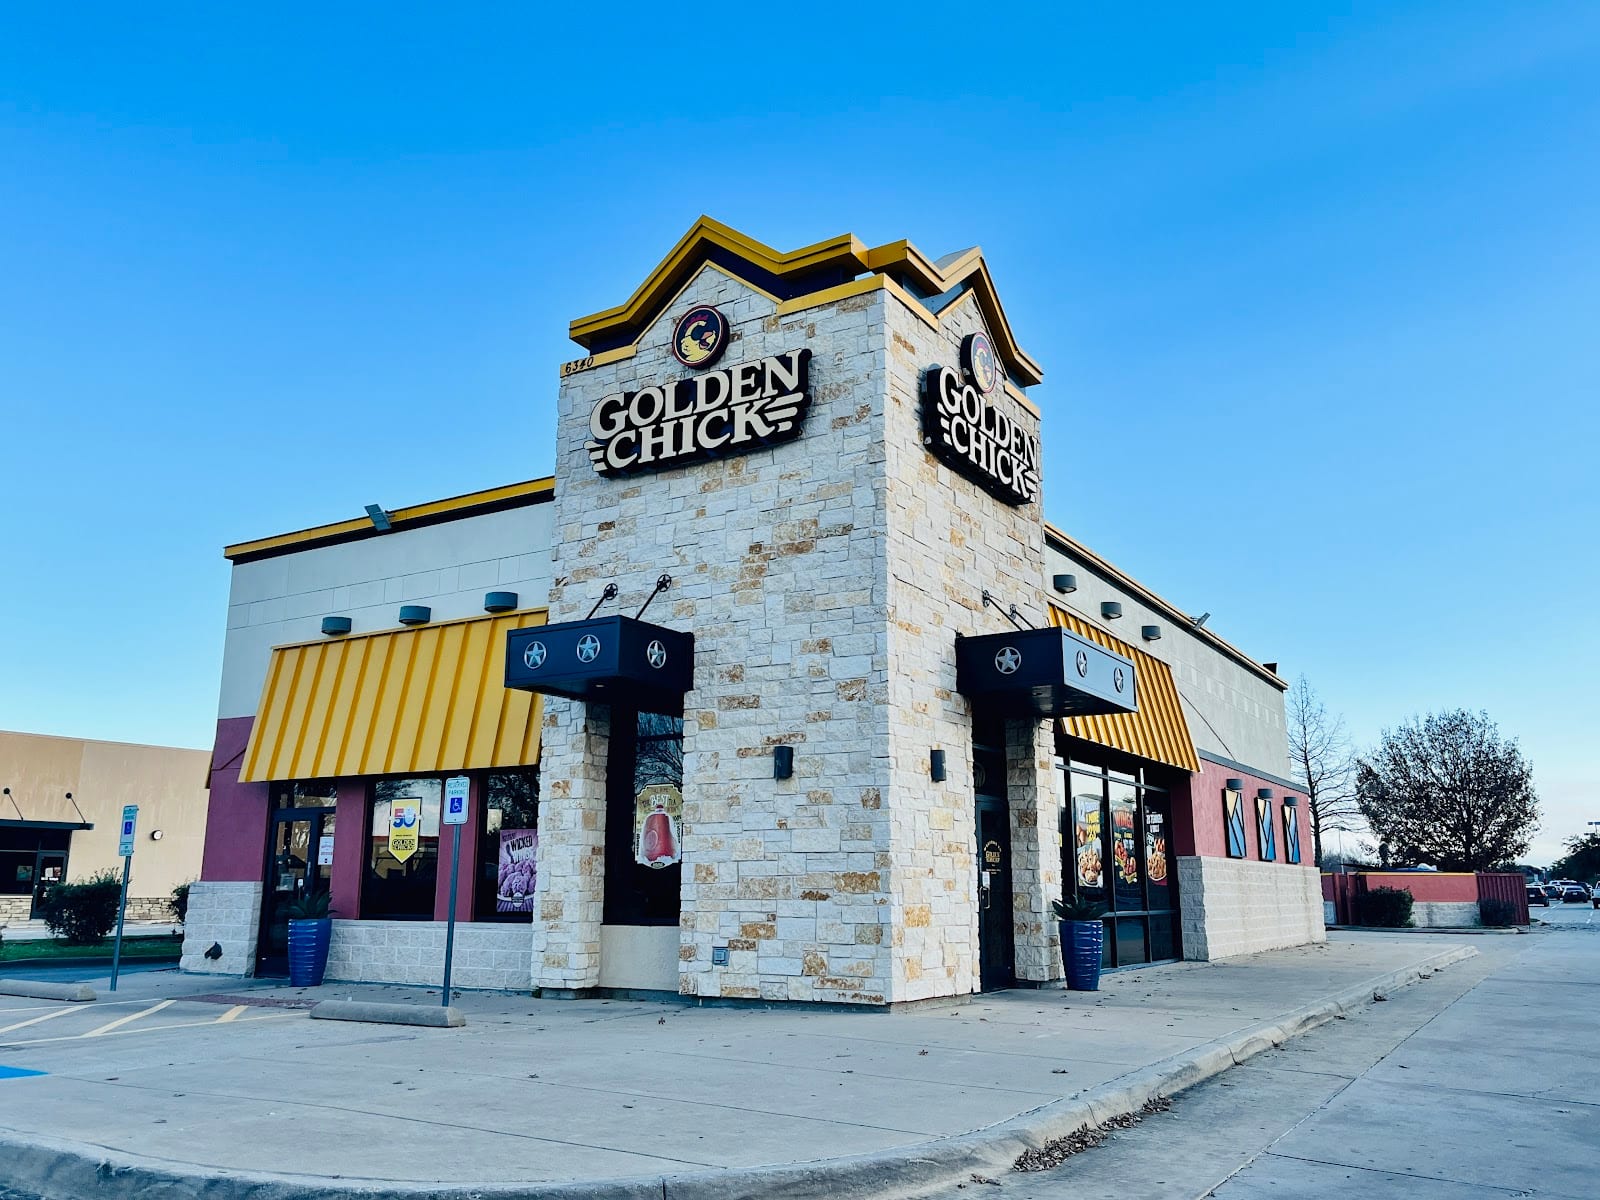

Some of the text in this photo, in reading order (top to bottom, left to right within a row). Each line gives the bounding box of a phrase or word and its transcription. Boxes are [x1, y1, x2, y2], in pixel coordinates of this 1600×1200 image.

[565, 356, 594, 374] 6340
[589, 348, 802, 440] GOLDEN
[606, 397, 776, 469] CHICK
[939, 366, 1038, 471] GOLDEN
[951, 415, 1030, 499] CHICK
[393, 808, 416, 828] 50
[510, 835, 533, 851] WICKED
